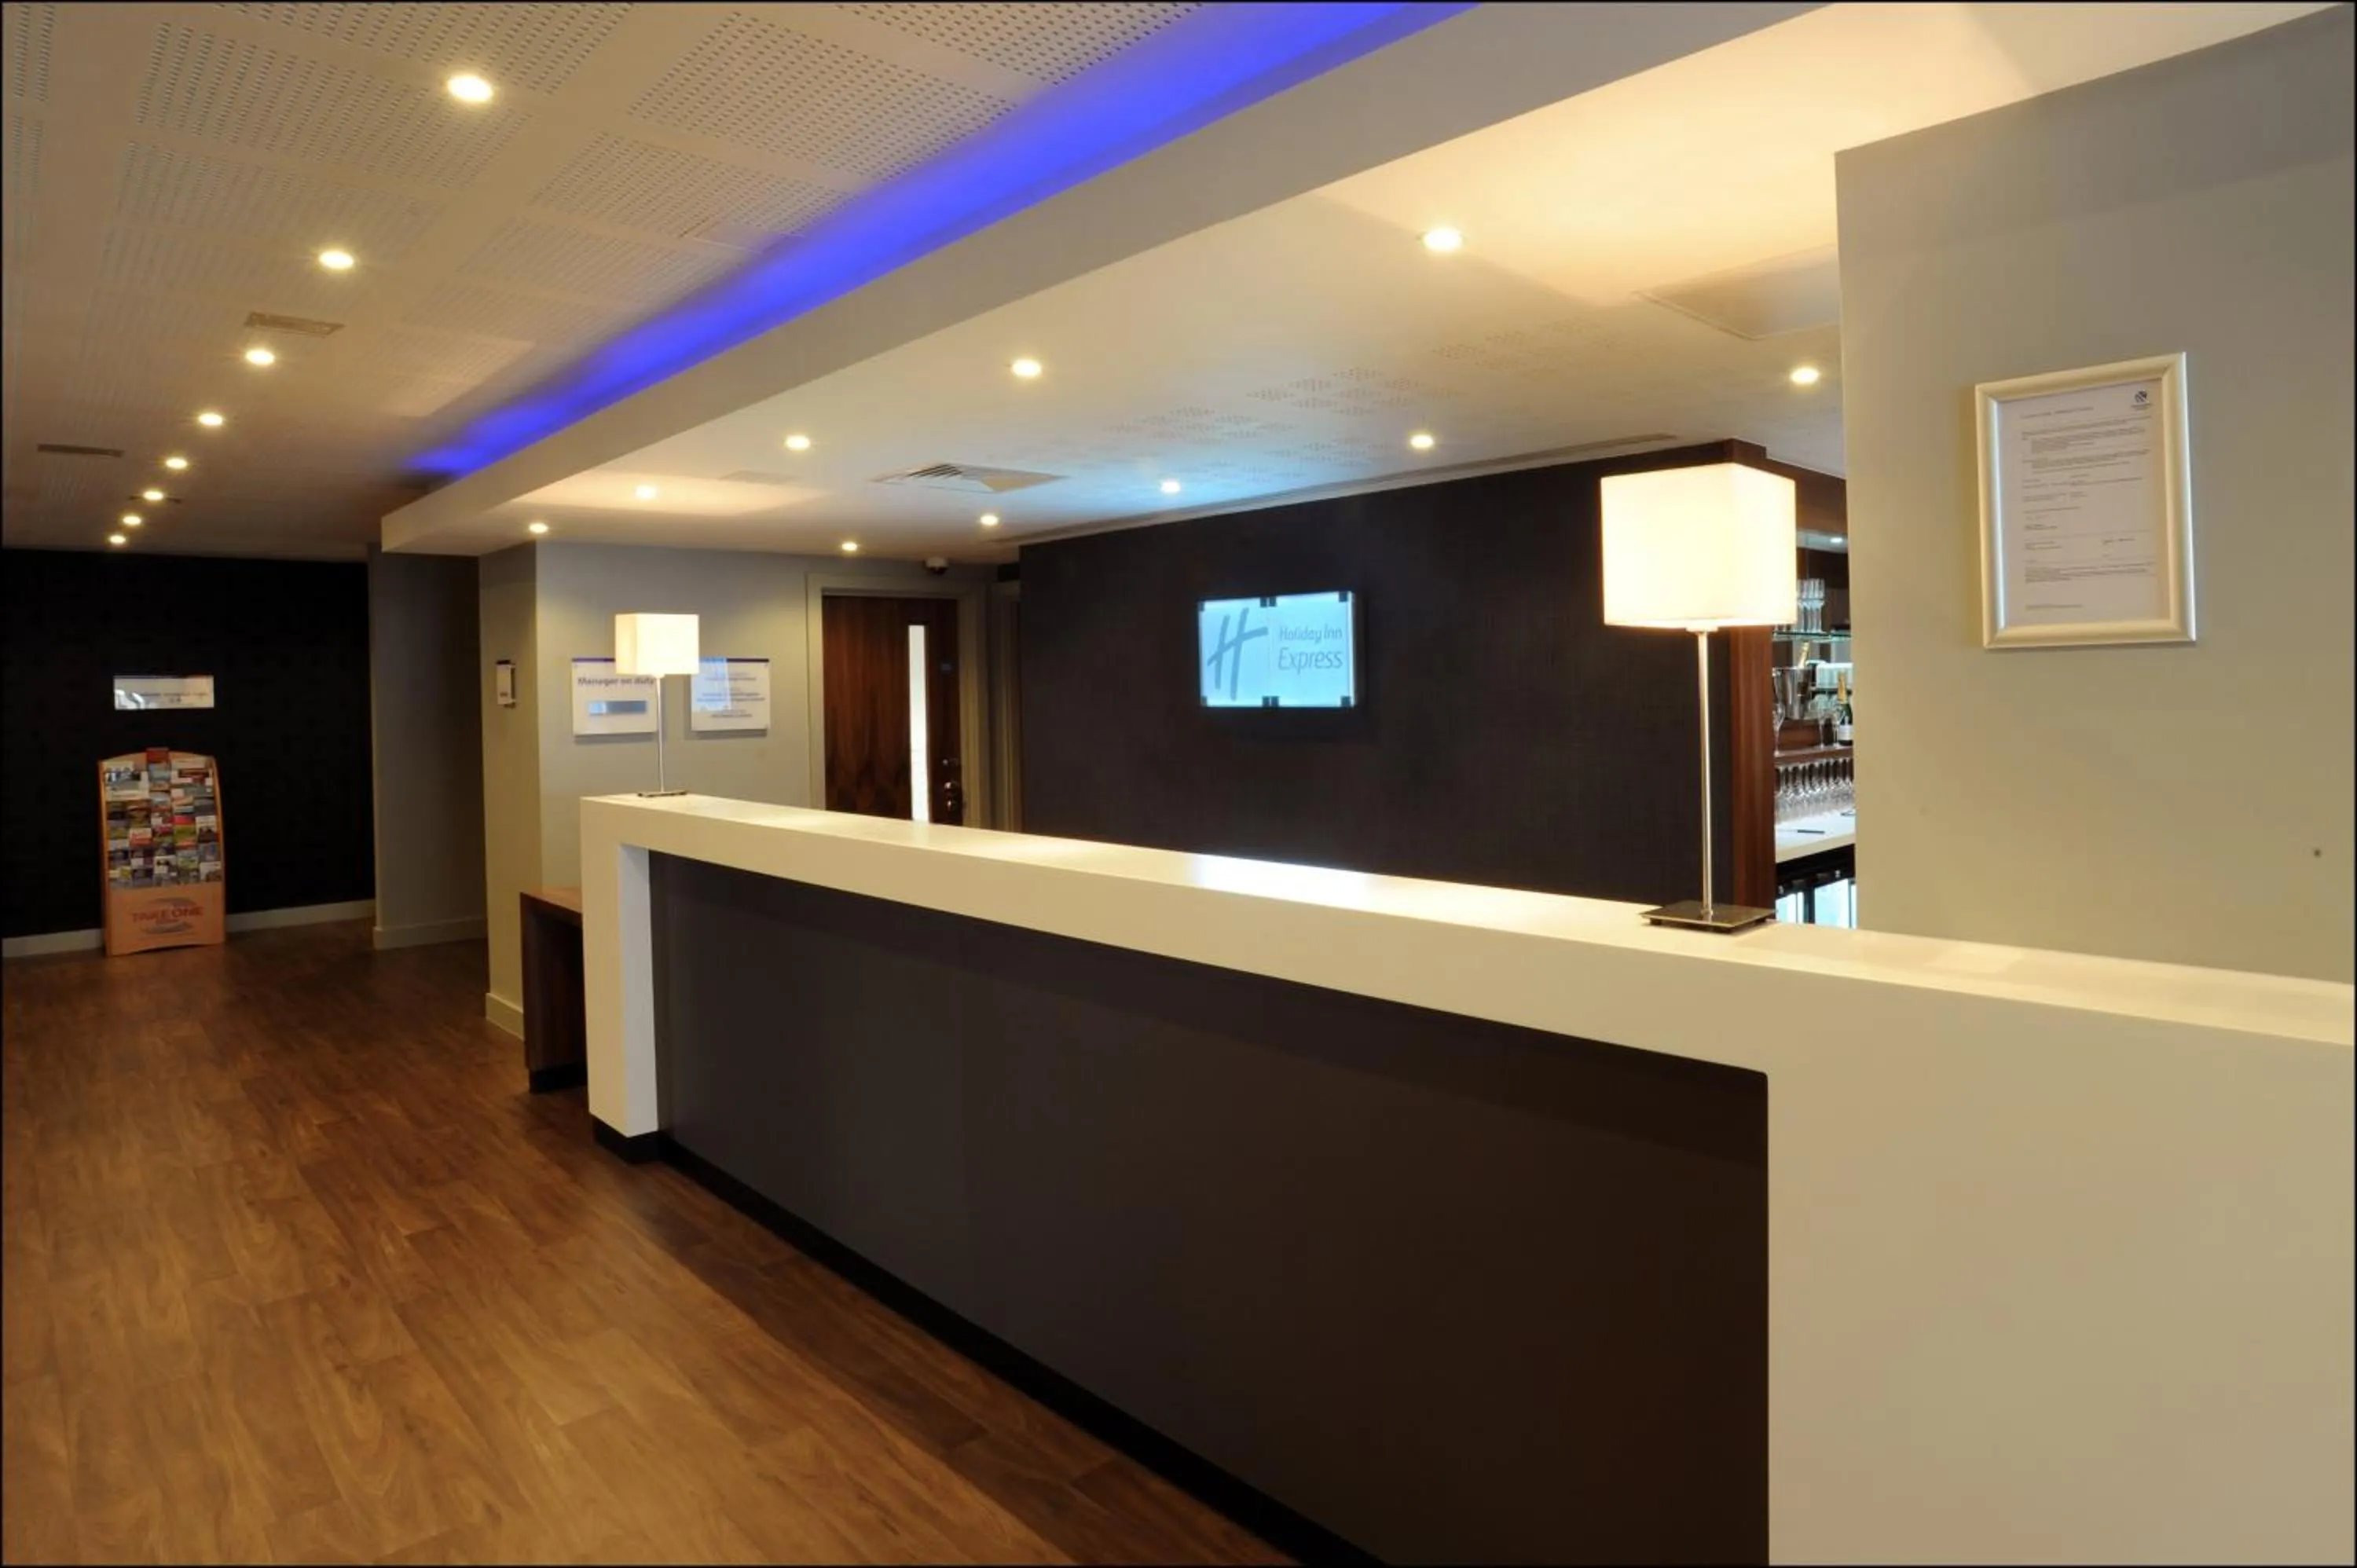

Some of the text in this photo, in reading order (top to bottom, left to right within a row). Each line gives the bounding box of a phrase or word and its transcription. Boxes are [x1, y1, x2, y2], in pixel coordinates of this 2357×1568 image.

[1279, 623, 1343, 643] Holiday Inn
[1278, 647, 1343, 675] Express
[577, 677, 618, 687] Manager
